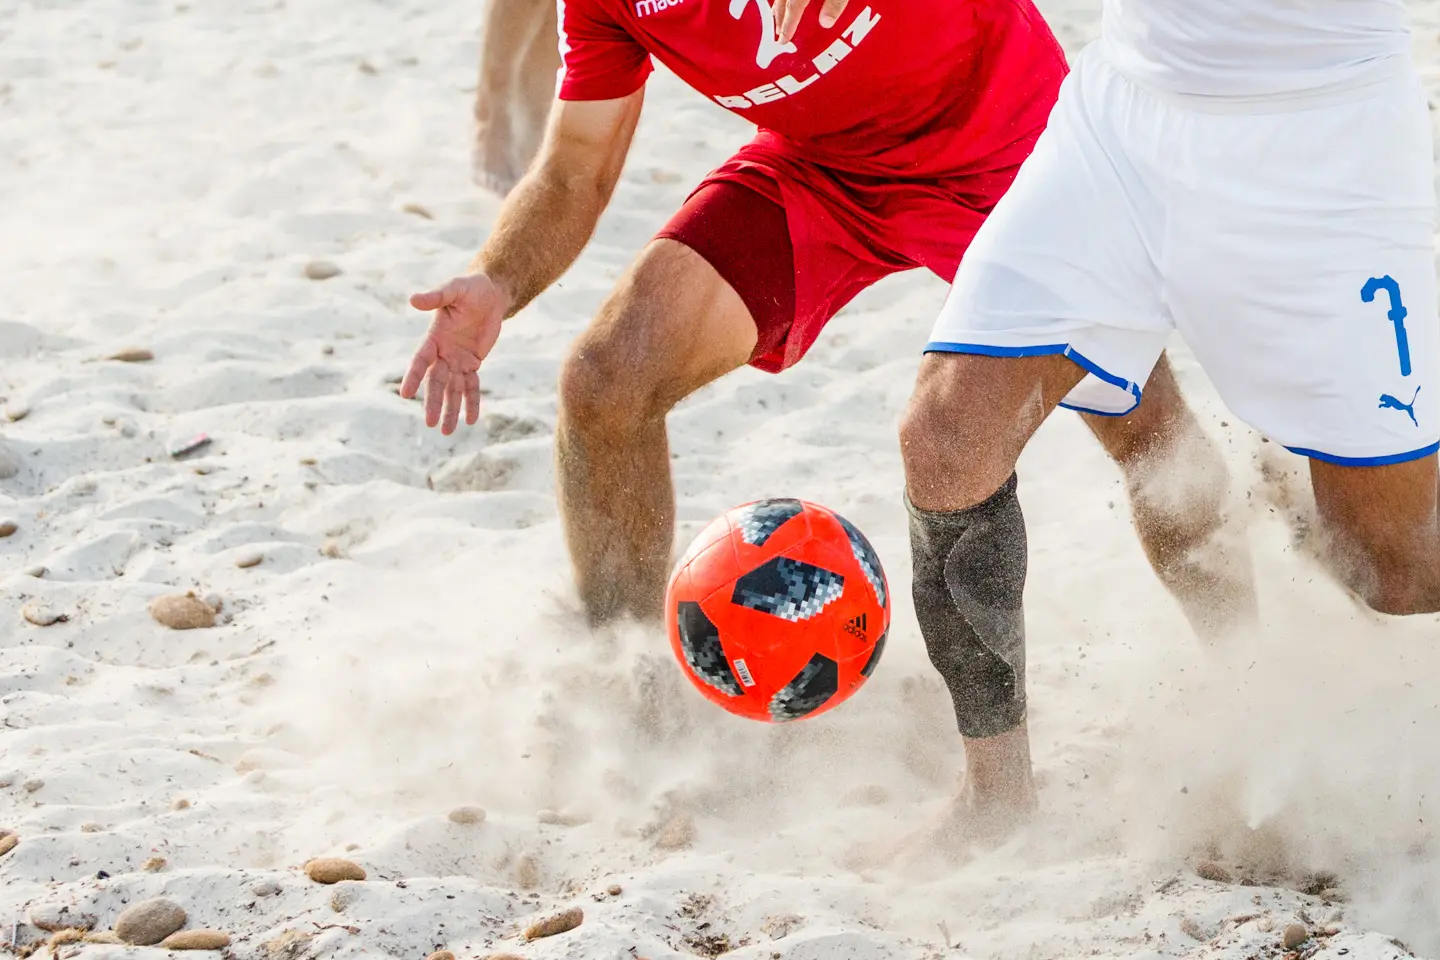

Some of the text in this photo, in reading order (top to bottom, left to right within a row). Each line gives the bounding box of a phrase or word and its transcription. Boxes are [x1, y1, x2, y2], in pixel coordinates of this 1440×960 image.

[712, 5, 882, 110] BELAZ
[1360, 274, 1412, 377] 7
[842, 623, 868, 644] adidas
